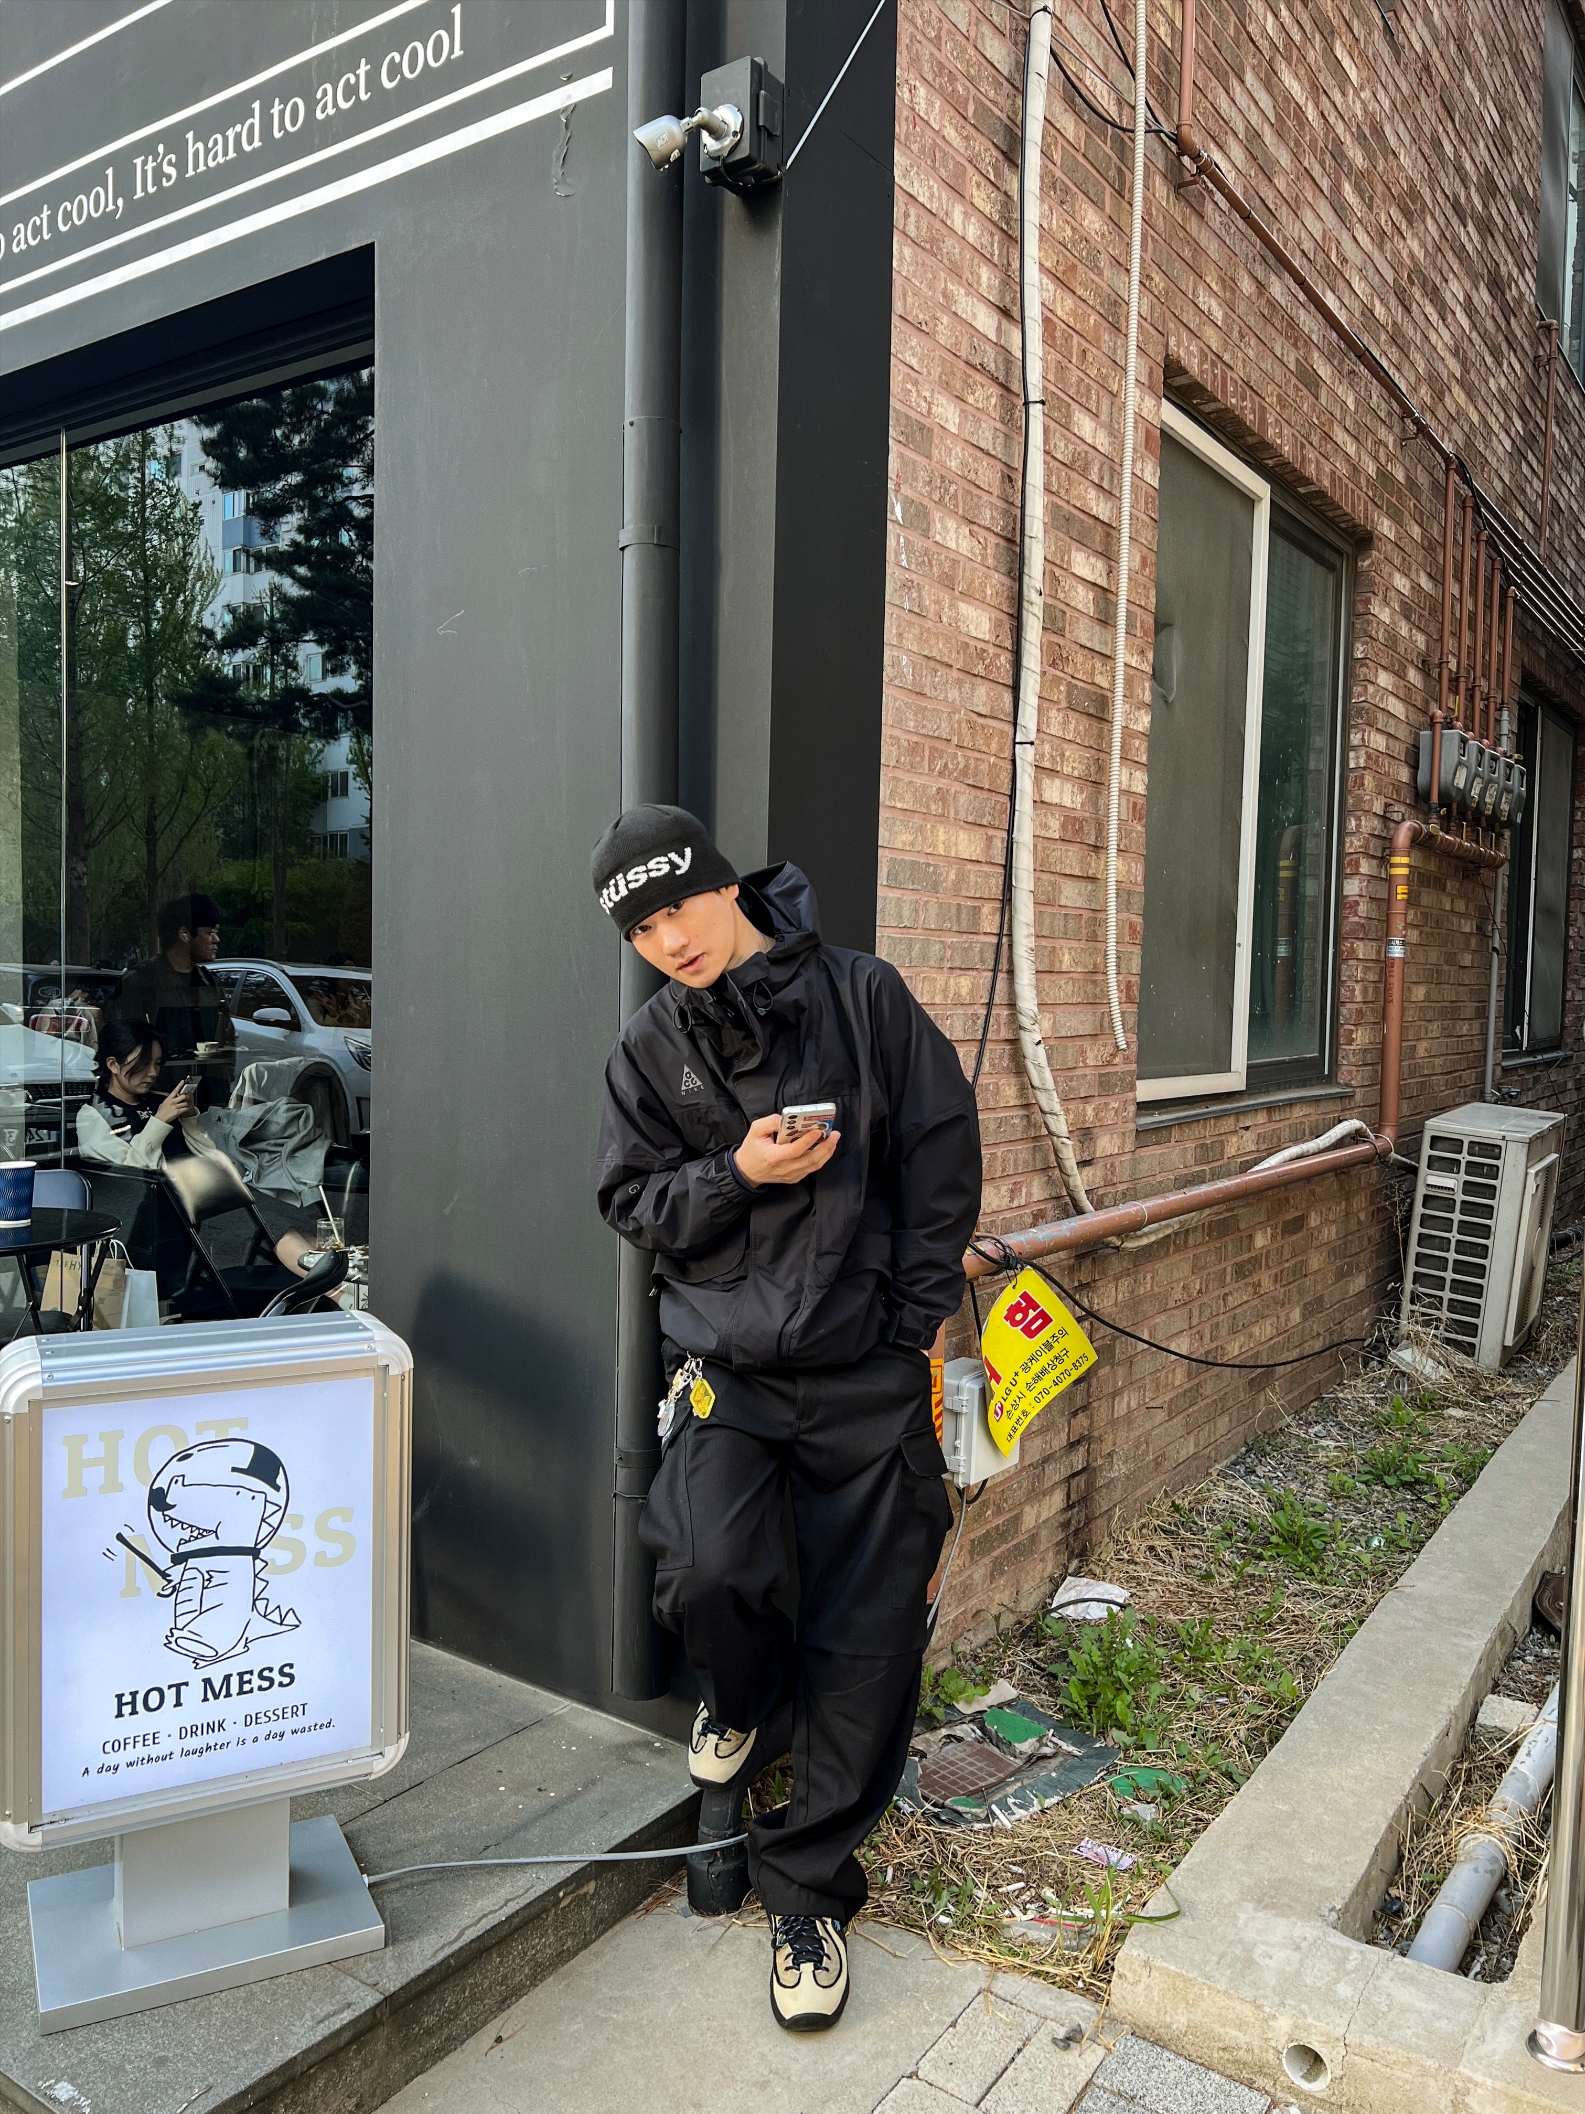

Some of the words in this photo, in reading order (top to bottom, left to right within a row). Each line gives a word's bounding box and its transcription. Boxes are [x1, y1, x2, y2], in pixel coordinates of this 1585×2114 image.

[12, 204, 51, 253] act
[57, 168, 123, 220] cool,
[133, 143, 177, 199] It's
[185, 100, 262, 178] hard
[270, 97, 305, 139] to
[315, 57, 372, 121] act
[380, 3, 465, 90] cool
[1006, 1391, 1027, 1420] 손상시
[1025, 1348, 1070, 1392] 손해배상청구
[1034, 1352, 1090, 1404] 070-4070-8375
[114, 1681, 189, 1719] HOT
[201, 1662, 296, 1703] MESS
[81, 1766, 90, 1778] A
[96, 1760, 120, 1775] day
[126, 1751, 174, 1768] without
[180, 1739, 231, 1759] laughter
[236, 1737, 246, 1747] is
[252, 1735, 259, 1744] a
[264, 1727, 286, 1742] day
[290, 1718, 336, 1736] wasted.
[102, 1731, 161, 1755] COFFEE
[178, 1718, 227, 1740] DRINK
[244, 1703, 308, 1727] DESSERT
